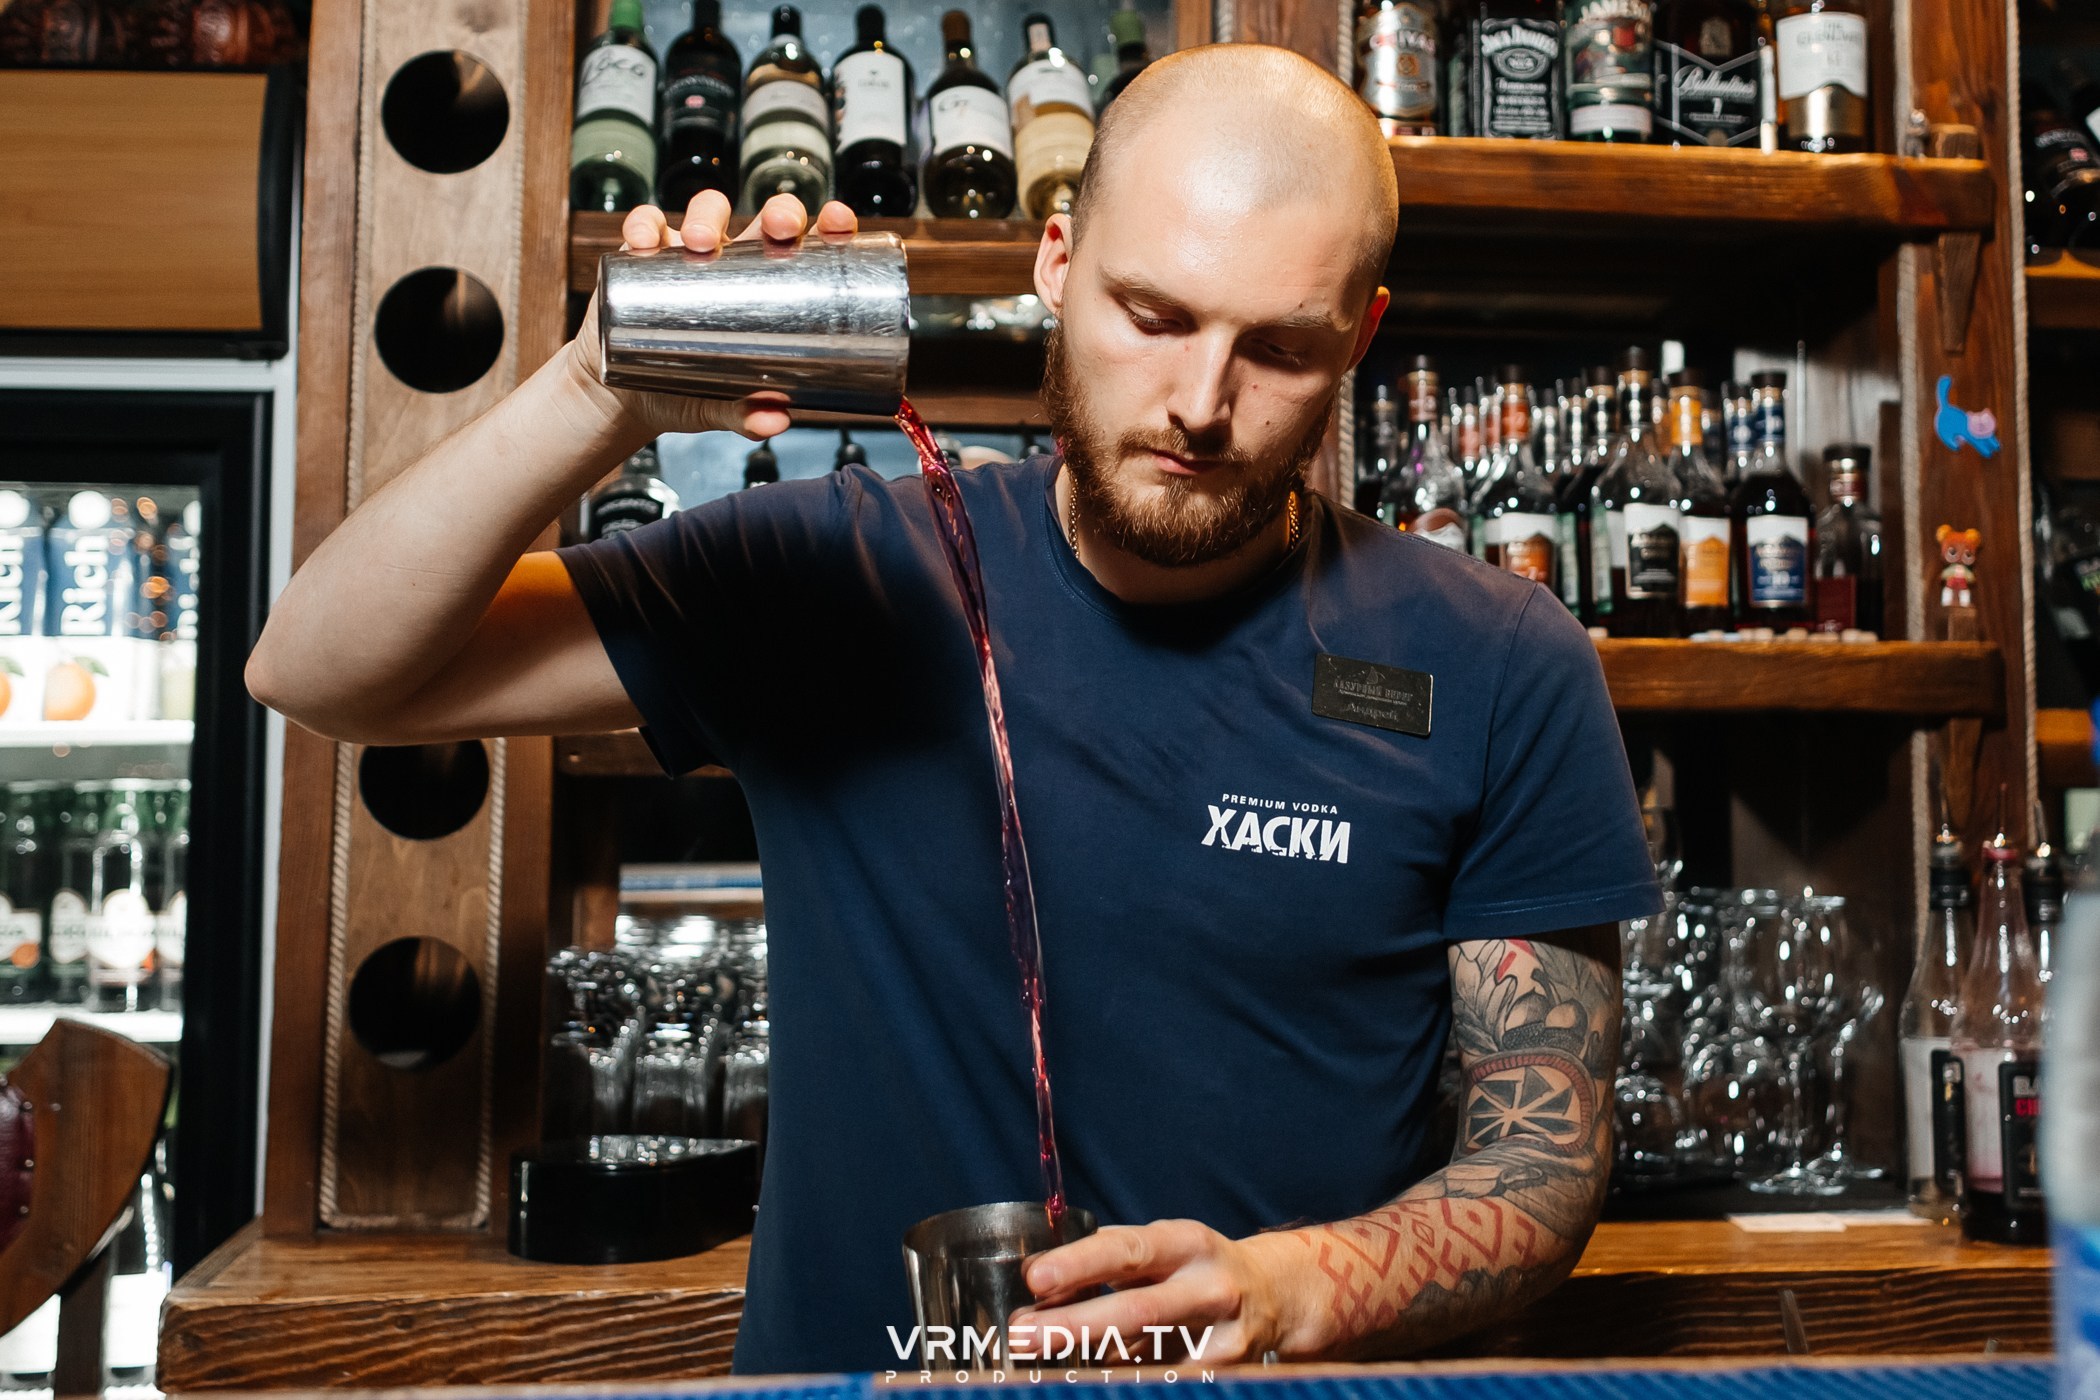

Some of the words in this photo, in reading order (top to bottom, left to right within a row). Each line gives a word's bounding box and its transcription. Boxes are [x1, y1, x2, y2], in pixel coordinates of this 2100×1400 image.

[60, 535, 110, 636] Rich
[1201, 804, 1351, 864] ХАСКИ
[1222, 793, 1286, 811] PREMIUM
[1292, 802, 1338, 815] VODKA
